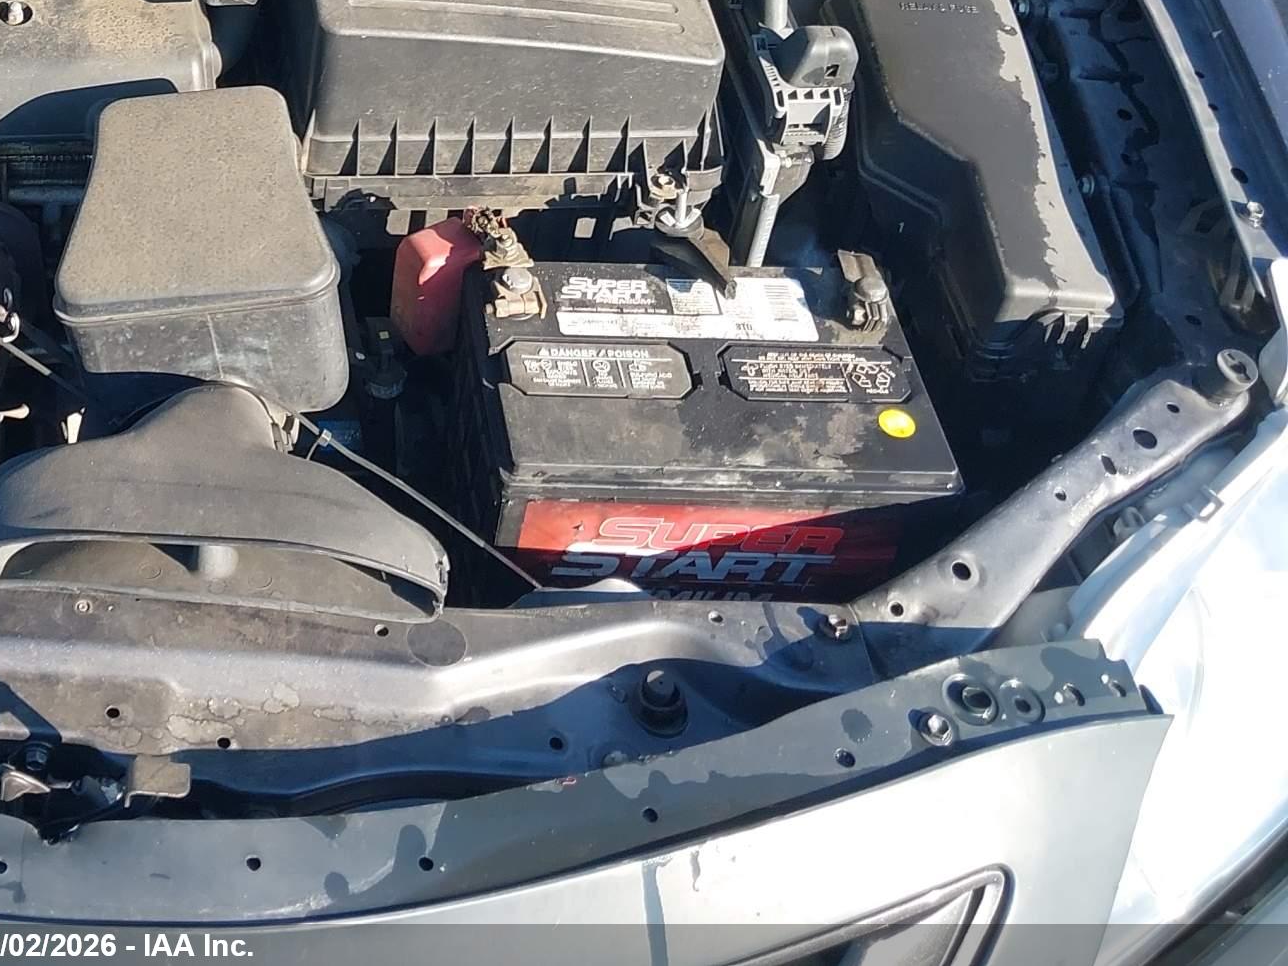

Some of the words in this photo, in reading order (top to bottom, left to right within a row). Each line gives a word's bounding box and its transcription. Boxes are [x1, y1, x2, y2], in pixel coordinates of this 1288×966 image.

[569, 276, 648, 291] SUPER
[560, 286, 649, 300] START
[551, 348, 597, 358] DANGER
[607, 349, 650, 359] POISON
[591, 515, 846, 555] SUPER
[550, 541, 837, 584] START
